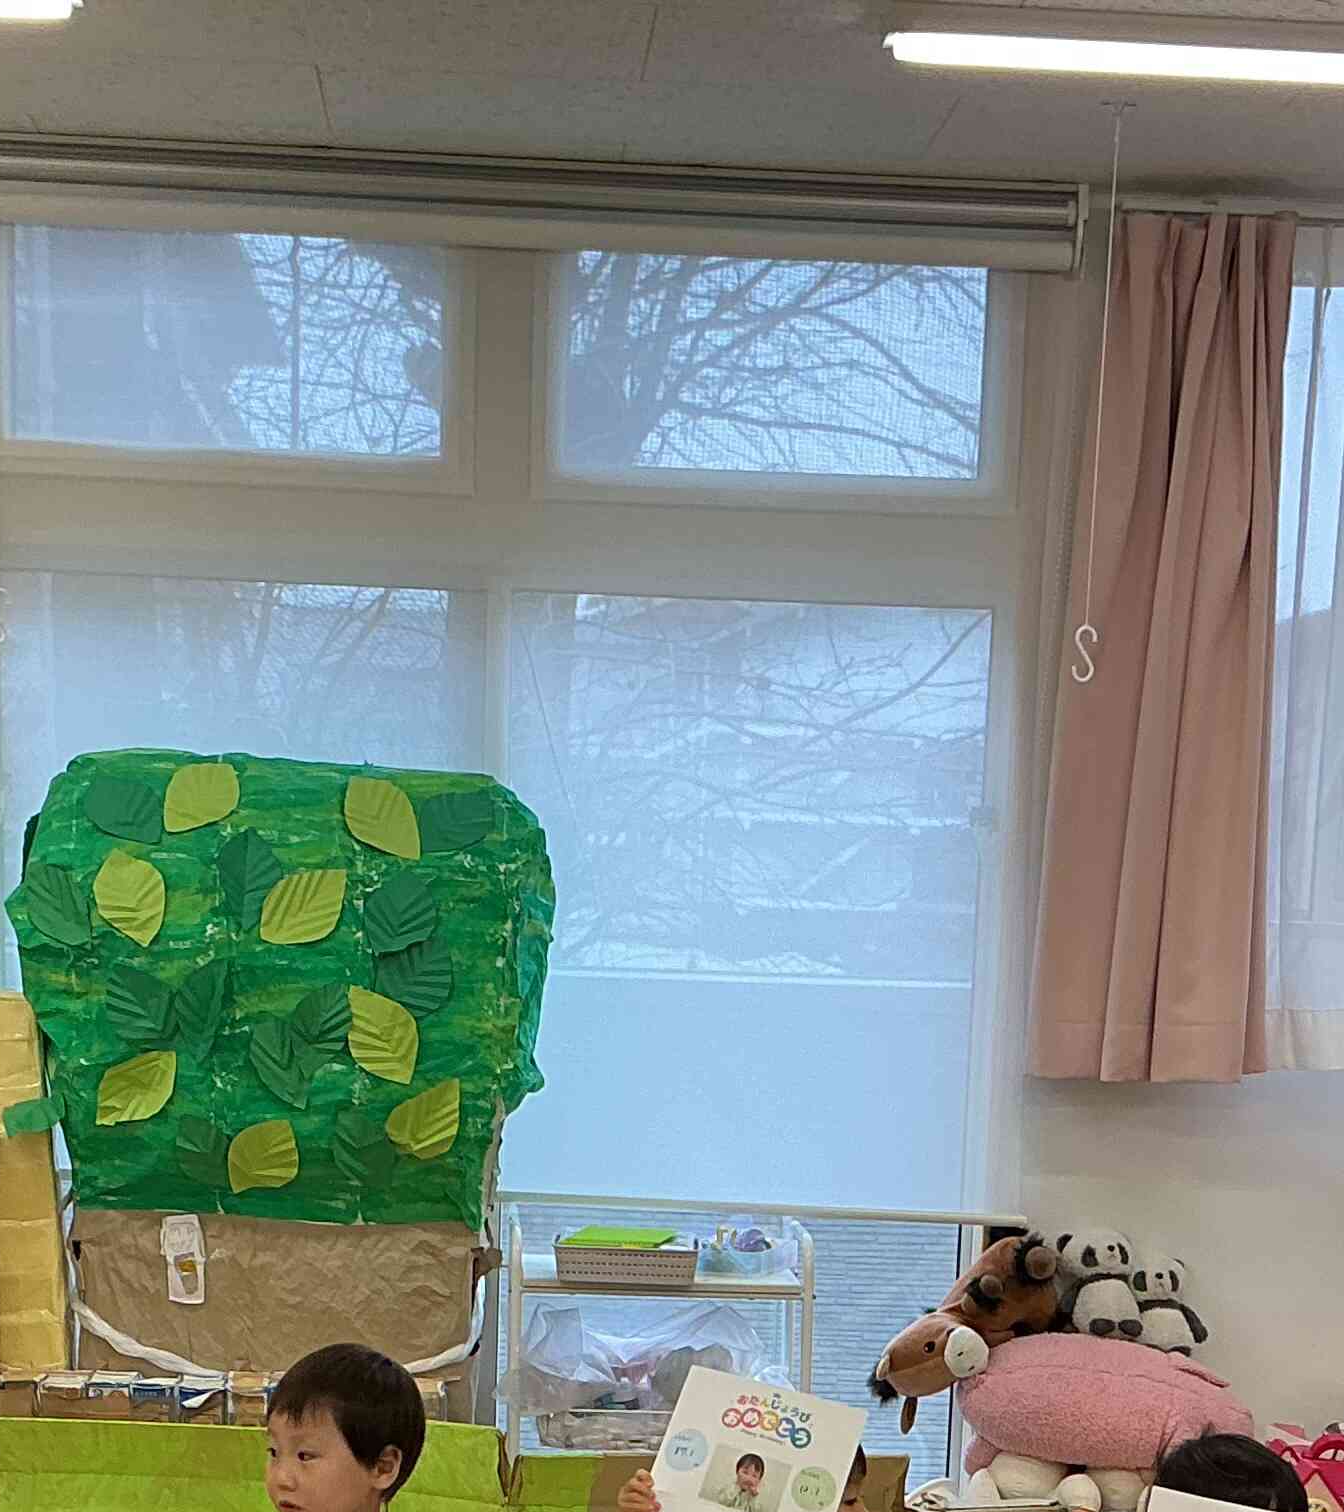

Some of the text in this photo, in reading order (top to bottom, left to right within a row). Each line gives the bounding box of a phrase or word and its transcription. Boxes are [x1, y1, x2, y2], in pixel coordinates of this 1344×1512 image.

[736, 1394, 812, 1423] おたんじょうび
[721, 1407, 812, 1449] おめでとう
